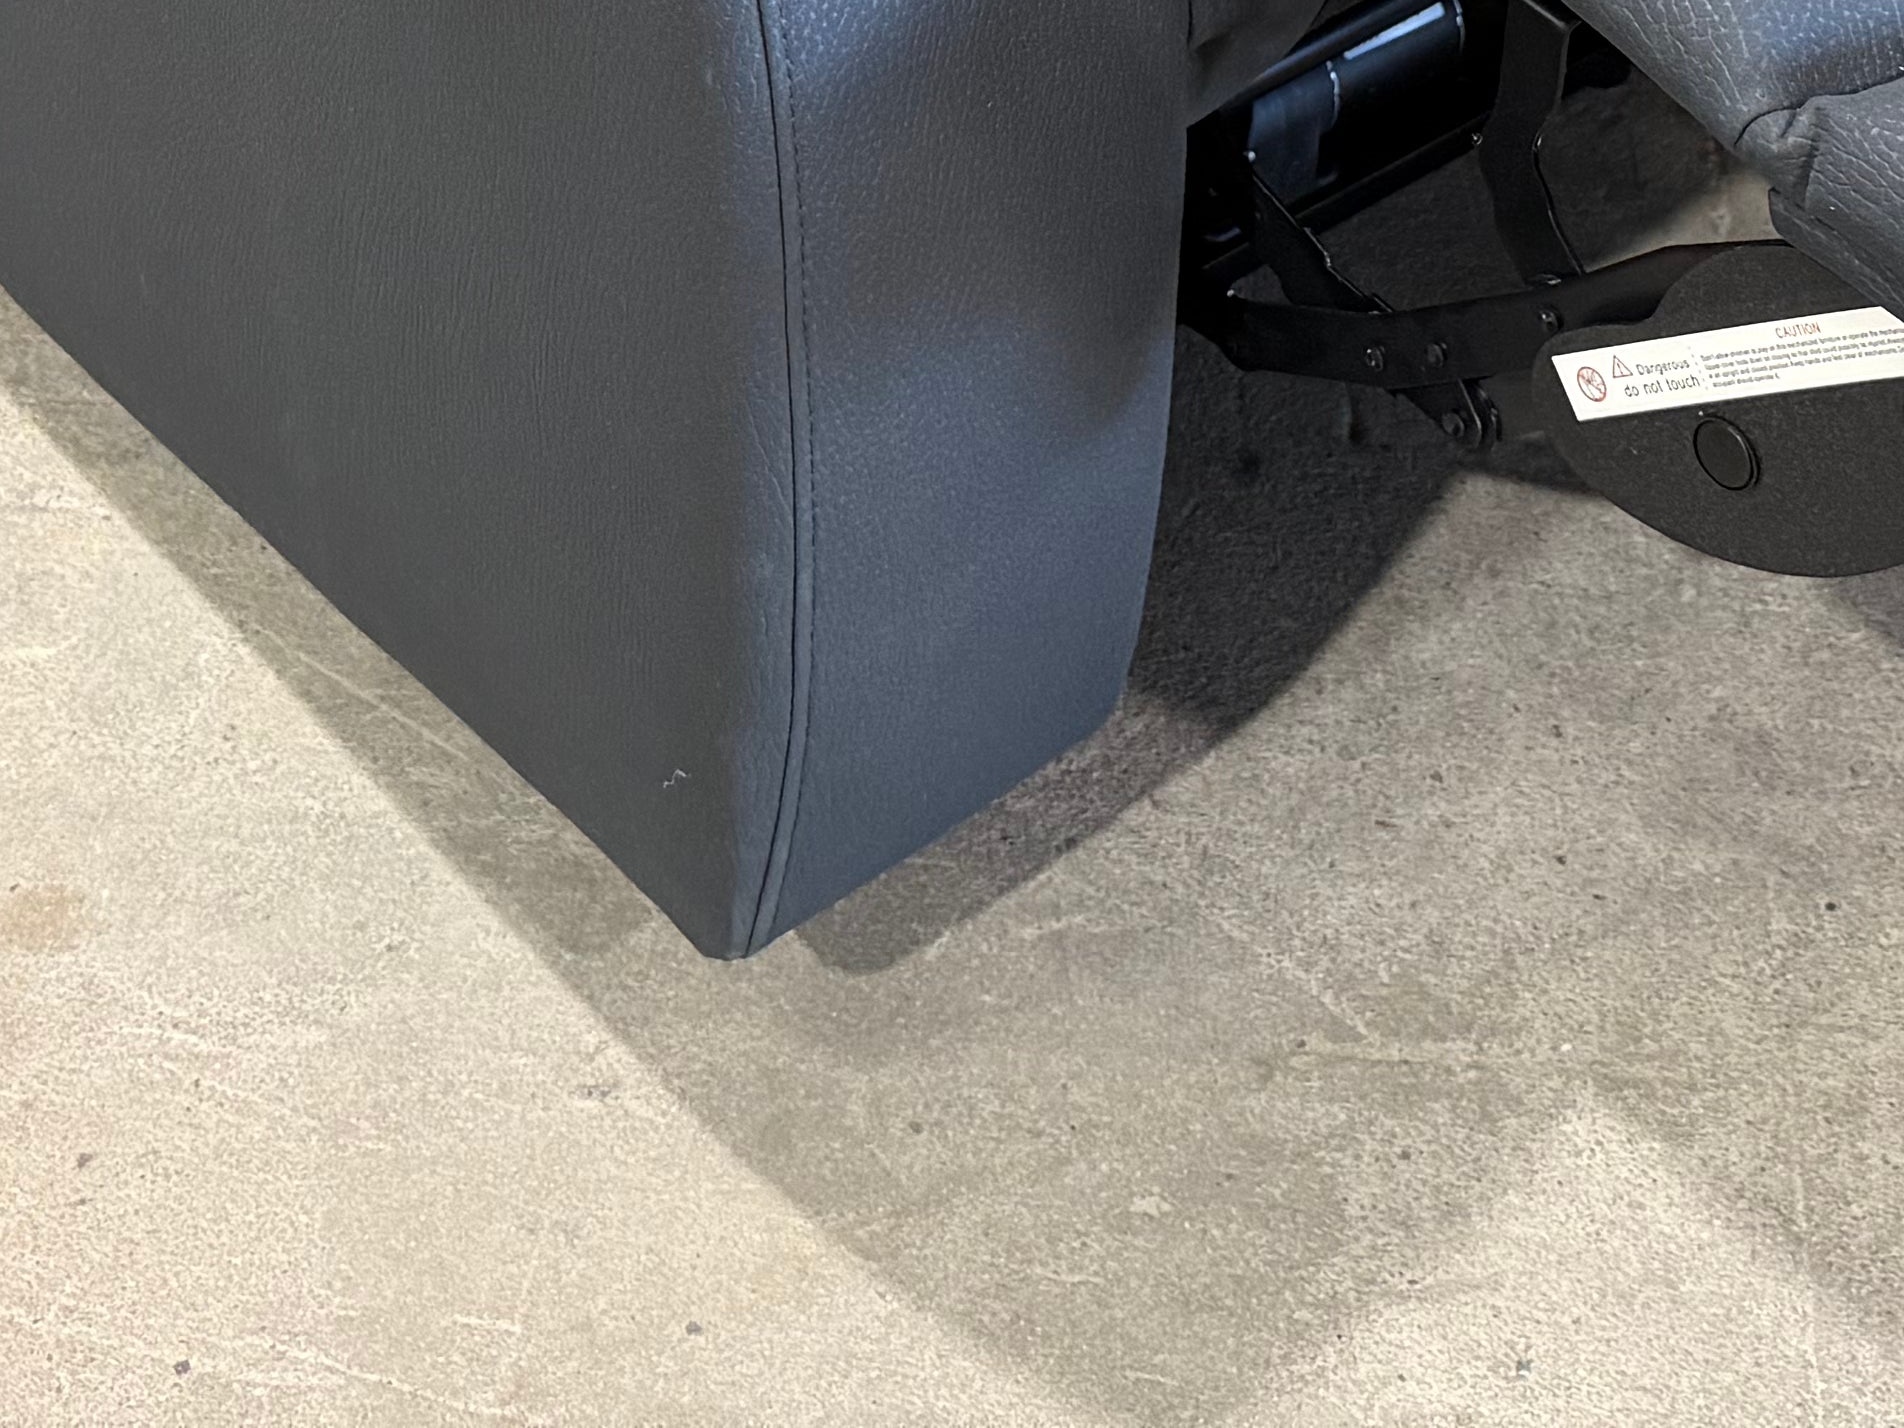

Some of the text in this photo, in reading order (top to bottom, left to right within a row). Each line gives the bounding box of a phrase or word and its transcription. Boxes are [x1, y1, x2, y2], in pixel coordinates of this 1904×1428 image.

[1775, 321, 1822, 339] CAUTION
[1635, 359, 1690, 376] Dangerous
[1624, 384, 1640, 397] do
[1644, 380, 1664, 395] not
[1666, 374, 1701, 392] touch
